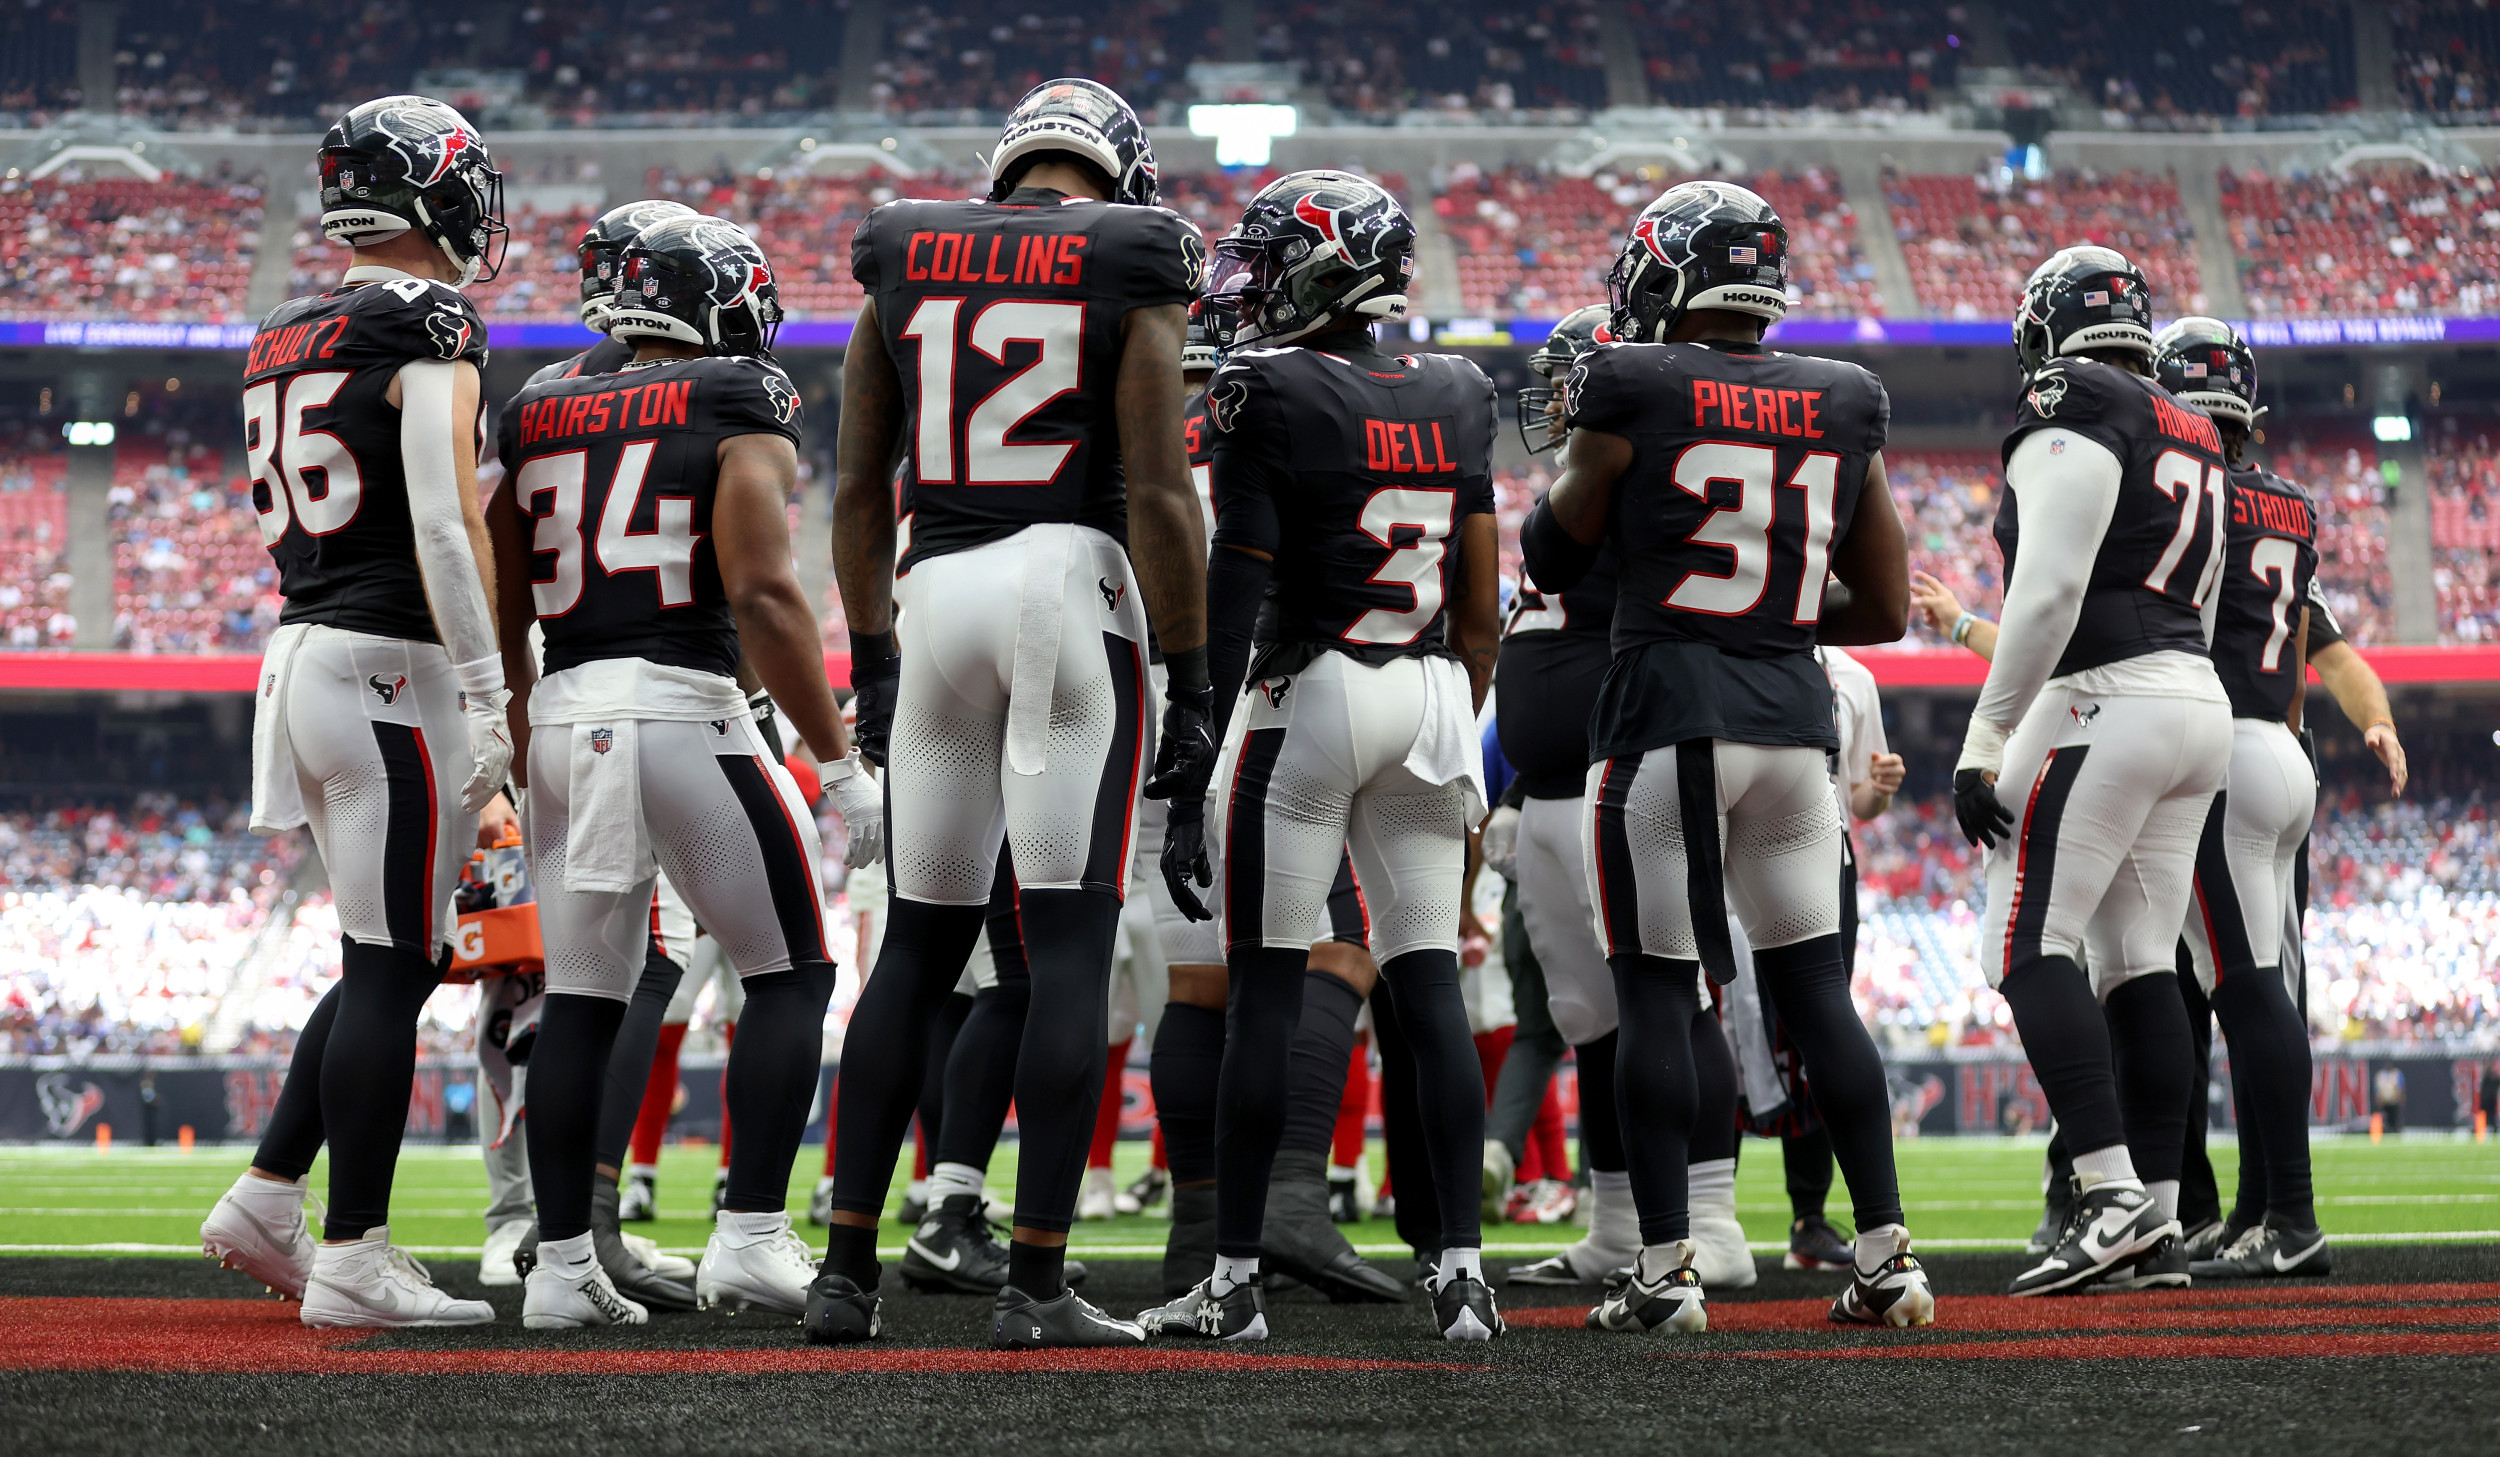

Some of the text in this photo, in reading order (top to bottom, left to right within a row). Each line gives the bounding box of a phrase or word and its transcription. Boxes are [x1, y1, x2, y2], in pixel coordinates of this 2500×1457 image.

[1003, 121, 1101, 147] HOUSTON
[906, 231, 1088, 286] COLLINS
[244, 315, 350, 378] SCHULTZ
[2083, 330, 2152, 345] HOUSTON
[519, 380, 692, 449] HAIRSTON
[898, 295, 1086, 486] 12
[1692, 379, 1825, 439] PIERCE
[1365, 418, 1457, 474] DELL
[2150, 395, 2221, 455] HOWARD
[242, 368, 365, 550] 86
[515, 437, 710, 620] 34
[1660, 439, 1844, 625] 31
[2142, 448, 2226, 609] 71
[2233, 485, 2310, 538] STROUD
[1337, 484, 1457, 646] 3
[2250, 535, 2299, 672] 7
[455, 920, 485, 962] G
[1031, 1326, 1042, 1340] 12
